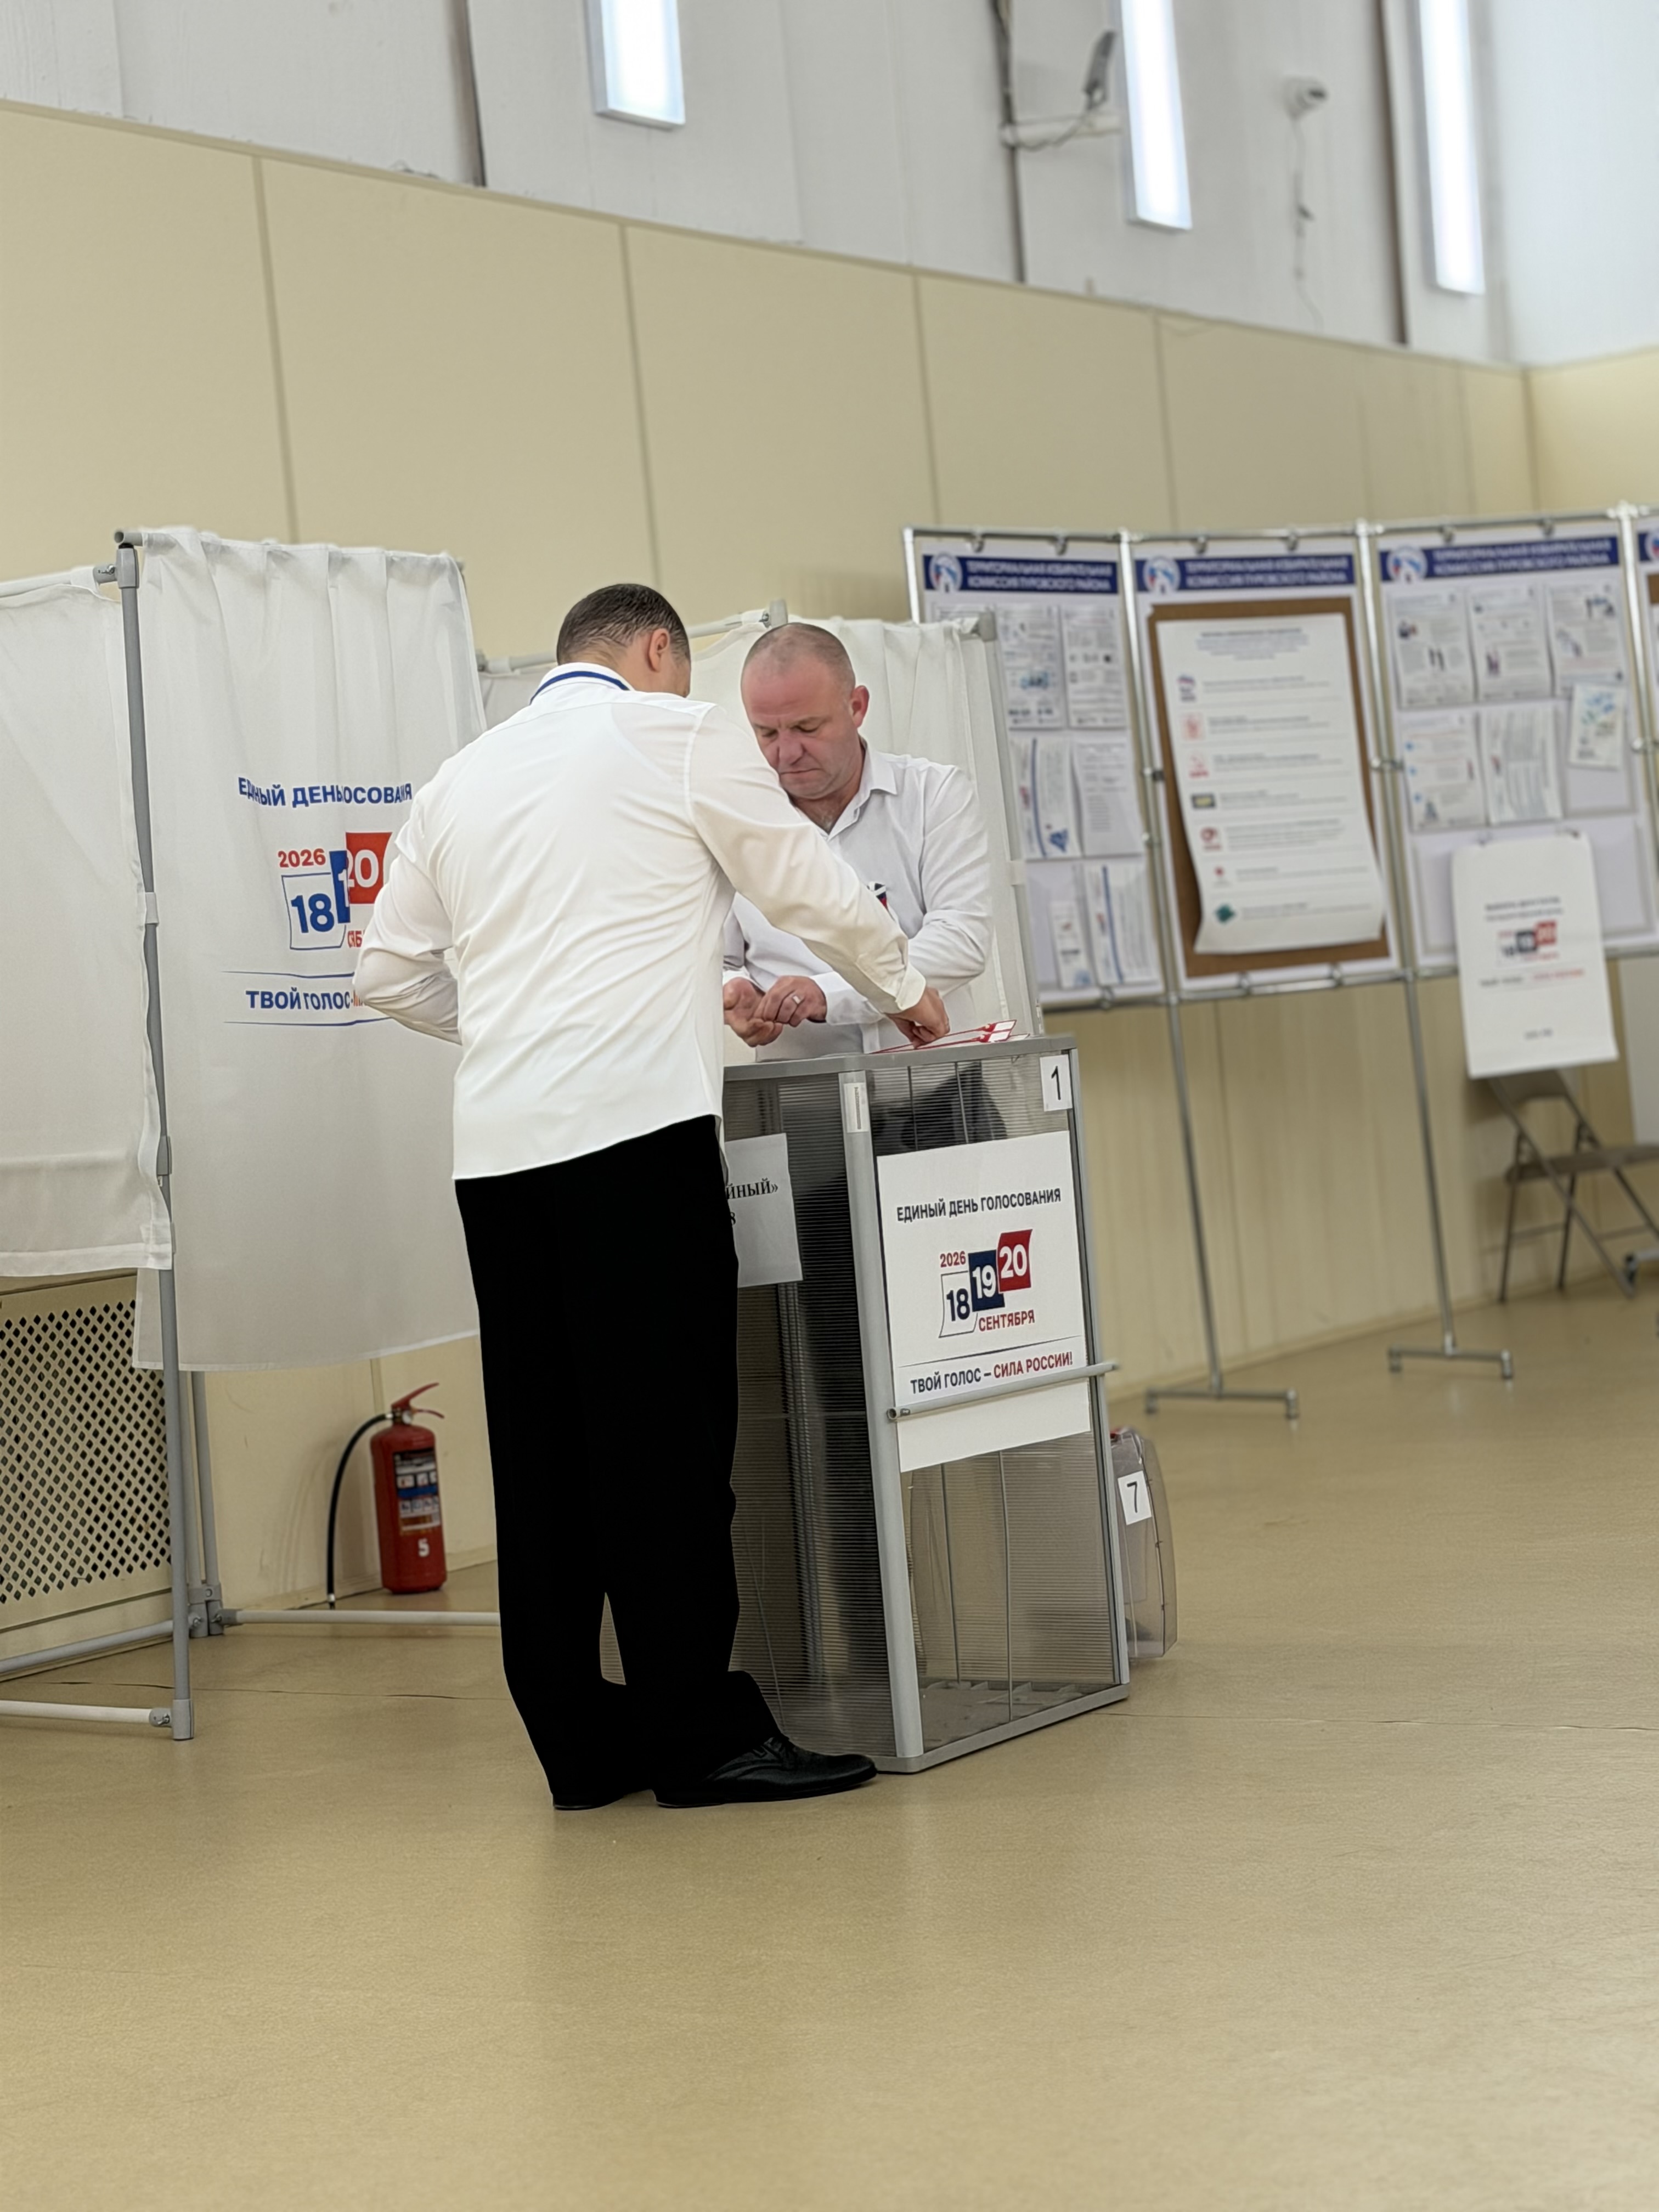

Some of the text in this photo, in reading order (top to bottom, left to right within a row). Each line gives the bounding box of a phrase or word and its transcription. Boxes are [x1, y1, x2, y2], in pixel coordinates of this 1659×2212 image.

[292, 785, 342, 808] ДЕНЬ
[278, 848, 326, 868] 2026
[291, 893, 335, 933] 18
[245, 987, 302, 1010] ТВОЙ
[1051, 1066, 1061, 1101] 1
[897, 1188, 1062, 1223] ЕДИНЫЙ ДЕНЬ ГОЛОСОВАНИЯ
[940, 1250, 966, 1268] 2026
[999, 1244, 1027, 1279] 20
[972, 1265, 996, 1299] 19
[946, 1288, 970, 1322] 18
[979, 1309, 1035, 1331] СЕНТЯБРЯ
[910, 1372, 941, 1394] ТВОЙ
[944, 1368, 981, 1389] ГОЛОС
[994, 1361, 1024, 1379] СИЛА
[1025, 1351, 1073, 1373] РОССИИ!
[1126, 1481, 1138, 1514] 7
[418, 1538, 430, 1558] 5
